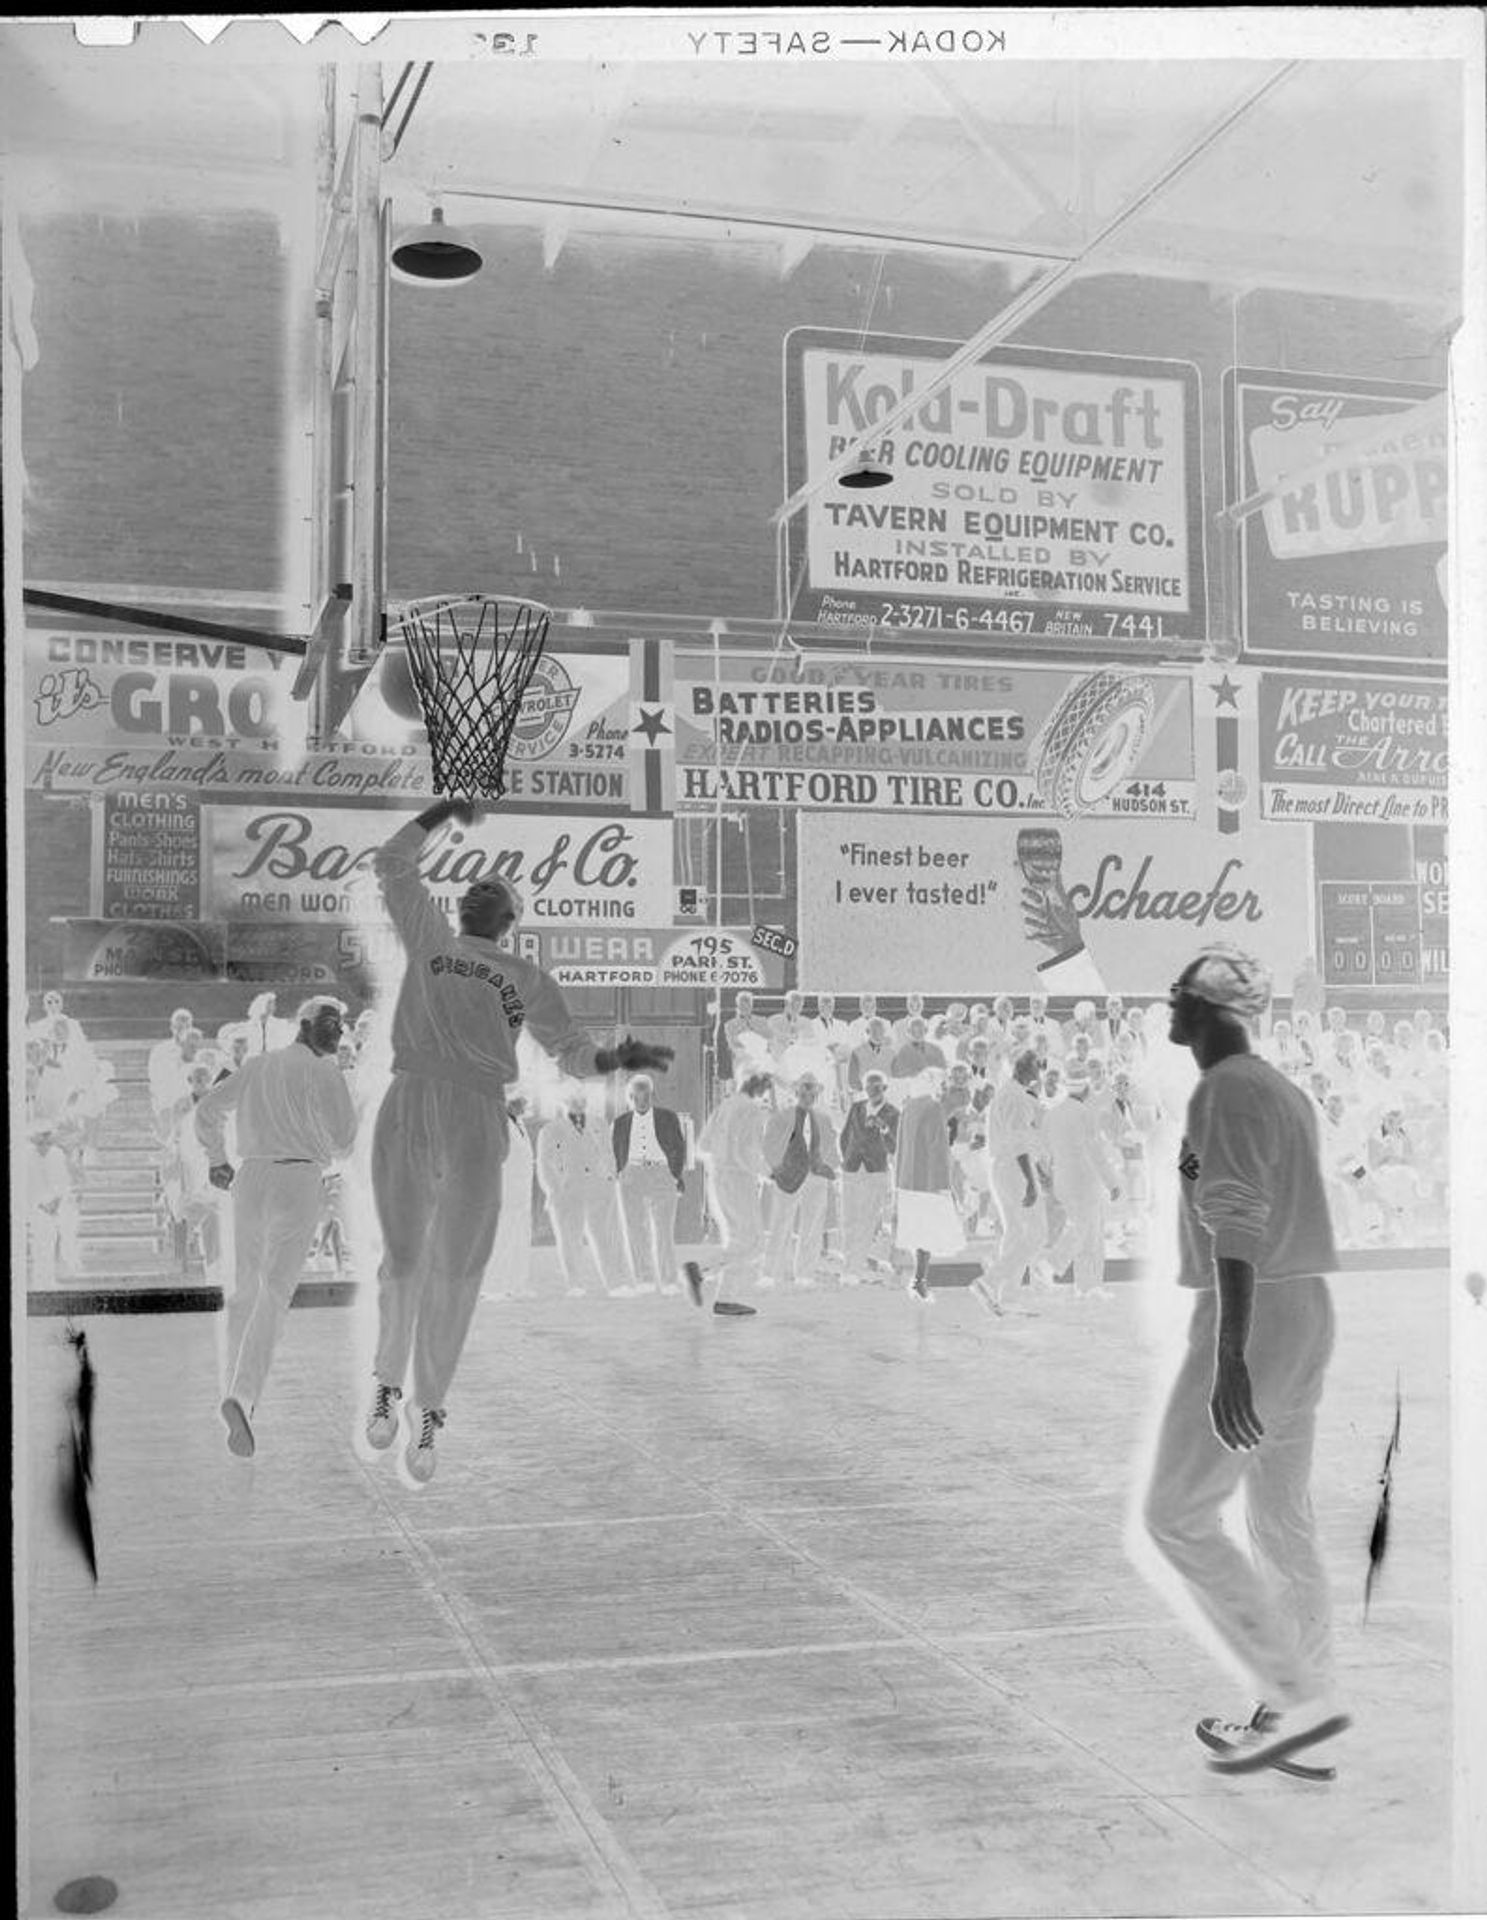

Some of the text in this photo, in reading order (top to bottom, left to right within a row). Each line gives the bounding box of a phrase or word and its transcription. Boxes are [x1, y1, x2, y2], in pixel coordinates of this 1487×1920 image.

[826, 362, 1164, 450] Kold-Draft
[1271, 395, 1344, 438] Say
[905, 440, 1010, 474] COOLING
[1019, 449, 1164, 483] EQUIPMENT
[930, 481, 1078, 509] SOLD BY
[824, 502, 1175, 548] TAVERN EQUIPMENT CO.
[896, 539, 1111, 568] INSTALLED BY
[834, 550, 1182, 597] HARTFORD REFRIGERATION SERVICE
[1055, 610, 1082, 622] NEW
[1286, 590, 1423, 615] TASTING IS
[880, 603, 1035, 634] 2-3271-6-4467
[1045, 621, 1093, 637] BRITAIN
[1103, 613, 1163, 639] 7441
[1302, 614, 1418, 637] BELIEVING
[48, 637, 246, 670] CONSERVE
[937, 675, 1013, 693] TIRES
[692, 687, 876, 715] BATTERIES
[1275, 687, 1358, 731] KEEP
[1365, 691, 1431, 710] YOUR
[718, 716, 1025, 743] RADIOS-APPLIANCES
[1348, 708, 1438, 736] Chartered
[168, 736, 240, 751] WEST
[568, 742, 625, 760] 3-5274
[1274, 732, 1327, 767] CALL
[1336, 734, 1369, 746] THE
[32, 750, 97, 785] New
[312, 757, 426, 795] Complete
[531, 769, 624, 798] STATION
[684, 768, 878, 803] HARTFORD
[887, 775, 963, 806] TIRE
[973, 779, 1025, 808] CO.
[1126, 781, 1167, 798] 414
[1112, 798, 1190, 814] HUDSON ST.
[1271, 789, 1294, 814] The
[1295, 797, 1331, 814] most
[1332, 791, 1380, 816] Direct
[1380, 793, 1412, 821] Line
[1413, 799, 1429, 817] to
[110, 812, 196, 830] CLOTHING
[573, 823, 640, 888] Co.
[840, 842, 970, 868] "Finest beer
[836, 880, 842, 903] I
[849, 886, 899, 904] ever
[1066, 854, 1263, 928] Schaefer
[533, 899, 635, 919] CLOTHING
[550, 936, 654, 960] WEAR
[690, 935, 734, 956] 795
[559, 970, 654, 983] HARTFORD
[663, 971, 707, 983] PHONE
[727, 956, 753, 970] ST.
